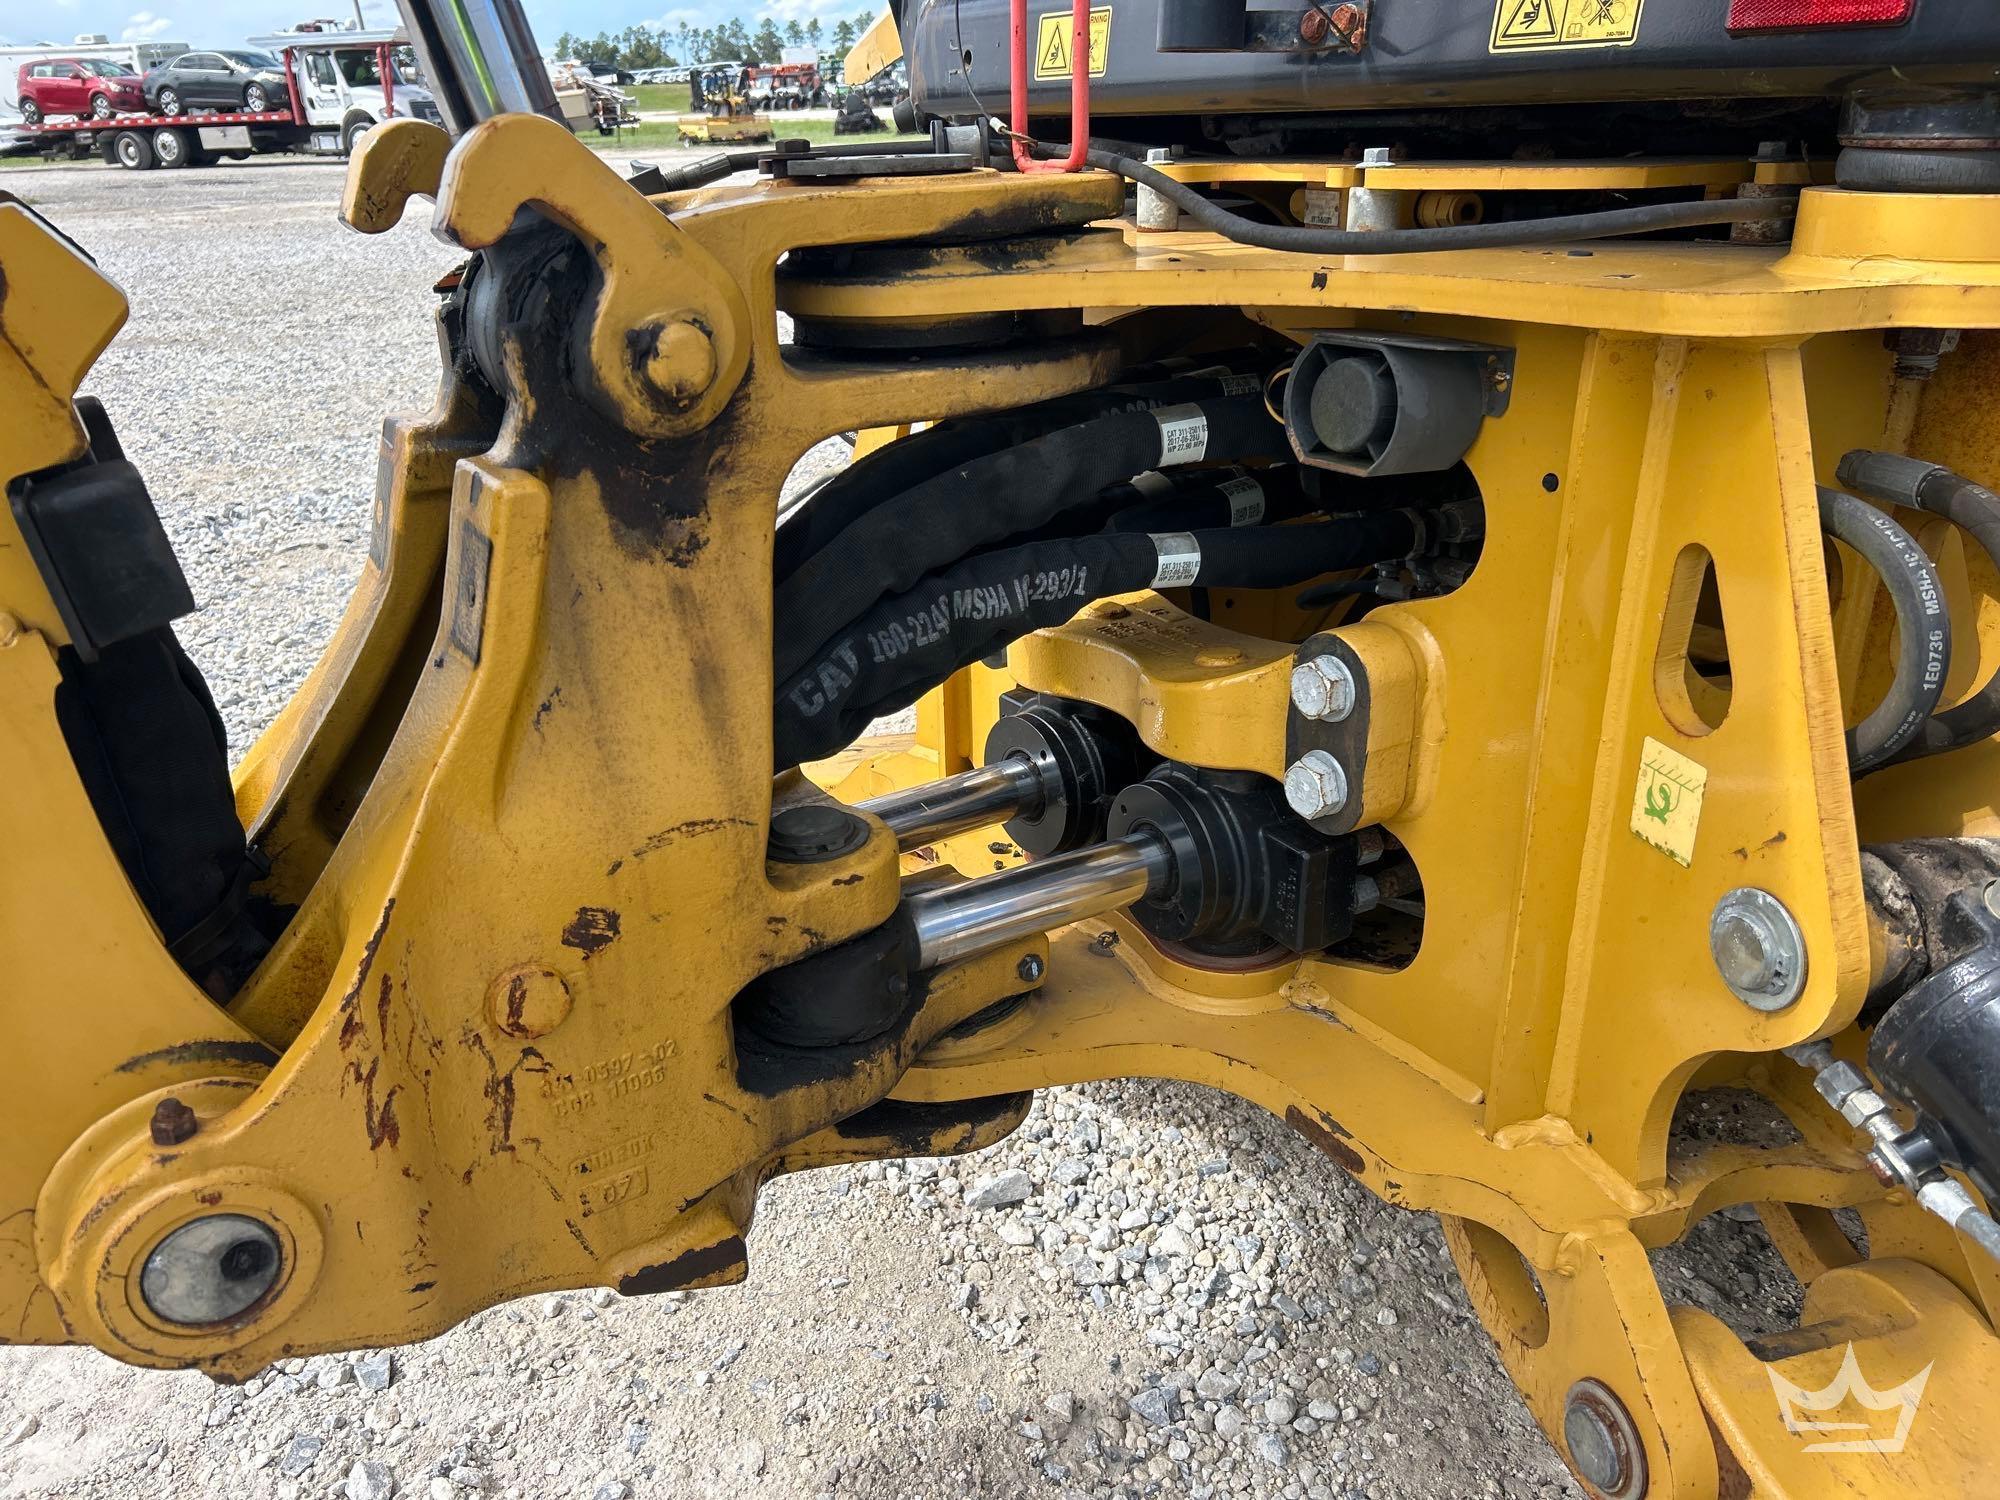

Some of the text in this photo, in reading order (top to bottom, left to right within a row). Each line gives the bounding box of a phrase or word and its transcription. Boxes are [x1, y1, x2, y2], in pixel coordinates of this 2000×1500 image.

[1166, 429, 1177, 440] CAT
[790, 637, 859, 717] CAT
[953, 584, 1012, 620] MSHA
[1923, 629, 1943, 691] 1E0736
